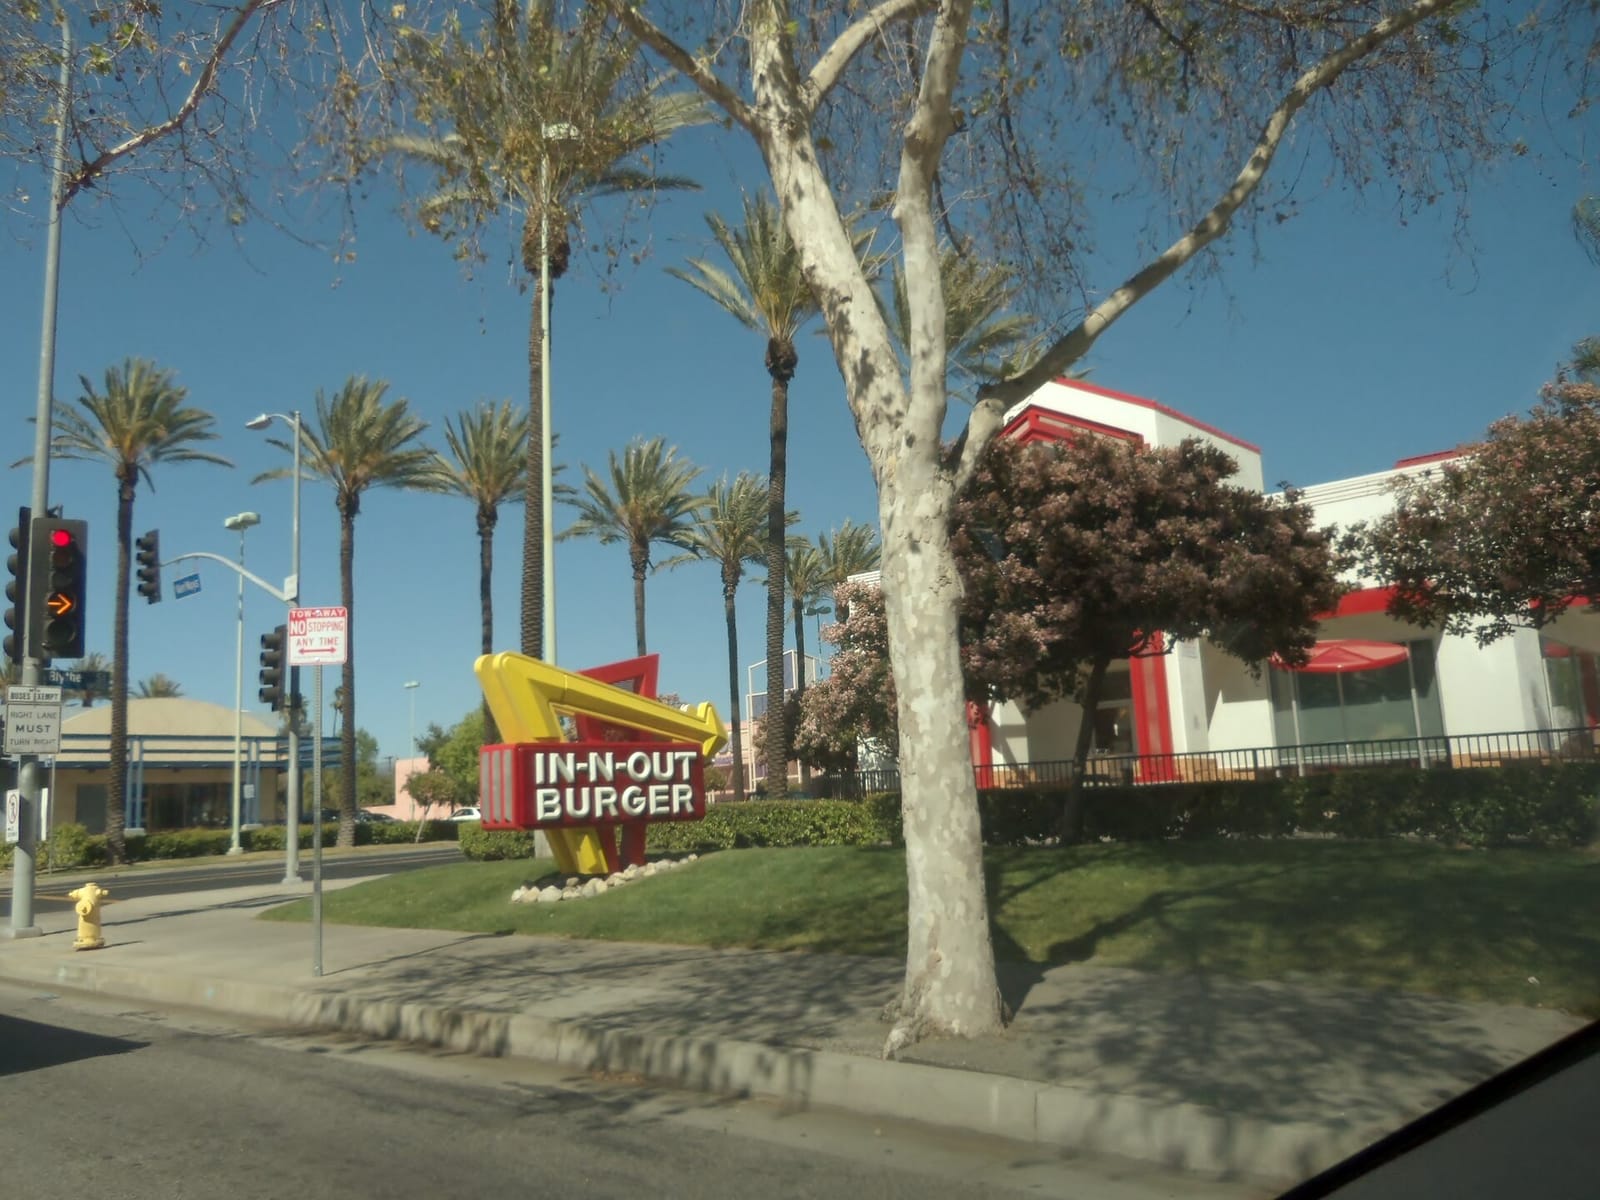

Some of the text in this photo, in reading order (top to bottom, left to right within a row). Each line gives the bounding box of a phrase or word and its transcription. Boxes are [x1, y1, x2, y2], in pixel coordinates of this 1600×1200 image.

[291, 609, 344, 618] TOW-AWAY
[290, 620, 344, 635] NO STOPPING
[296, 637, 340, 647] ANY TIME
[11, 692, 58, 700] BUSES EXEMPT
[10, 711, 58, 719] RIGHT LANE
[16, 724, 52, 733] MUST
[10, 738, 30, 746] TURN
[535, 752, 697, 785] IN-N-OUT
[536, 784, 694, 821] BURGER
